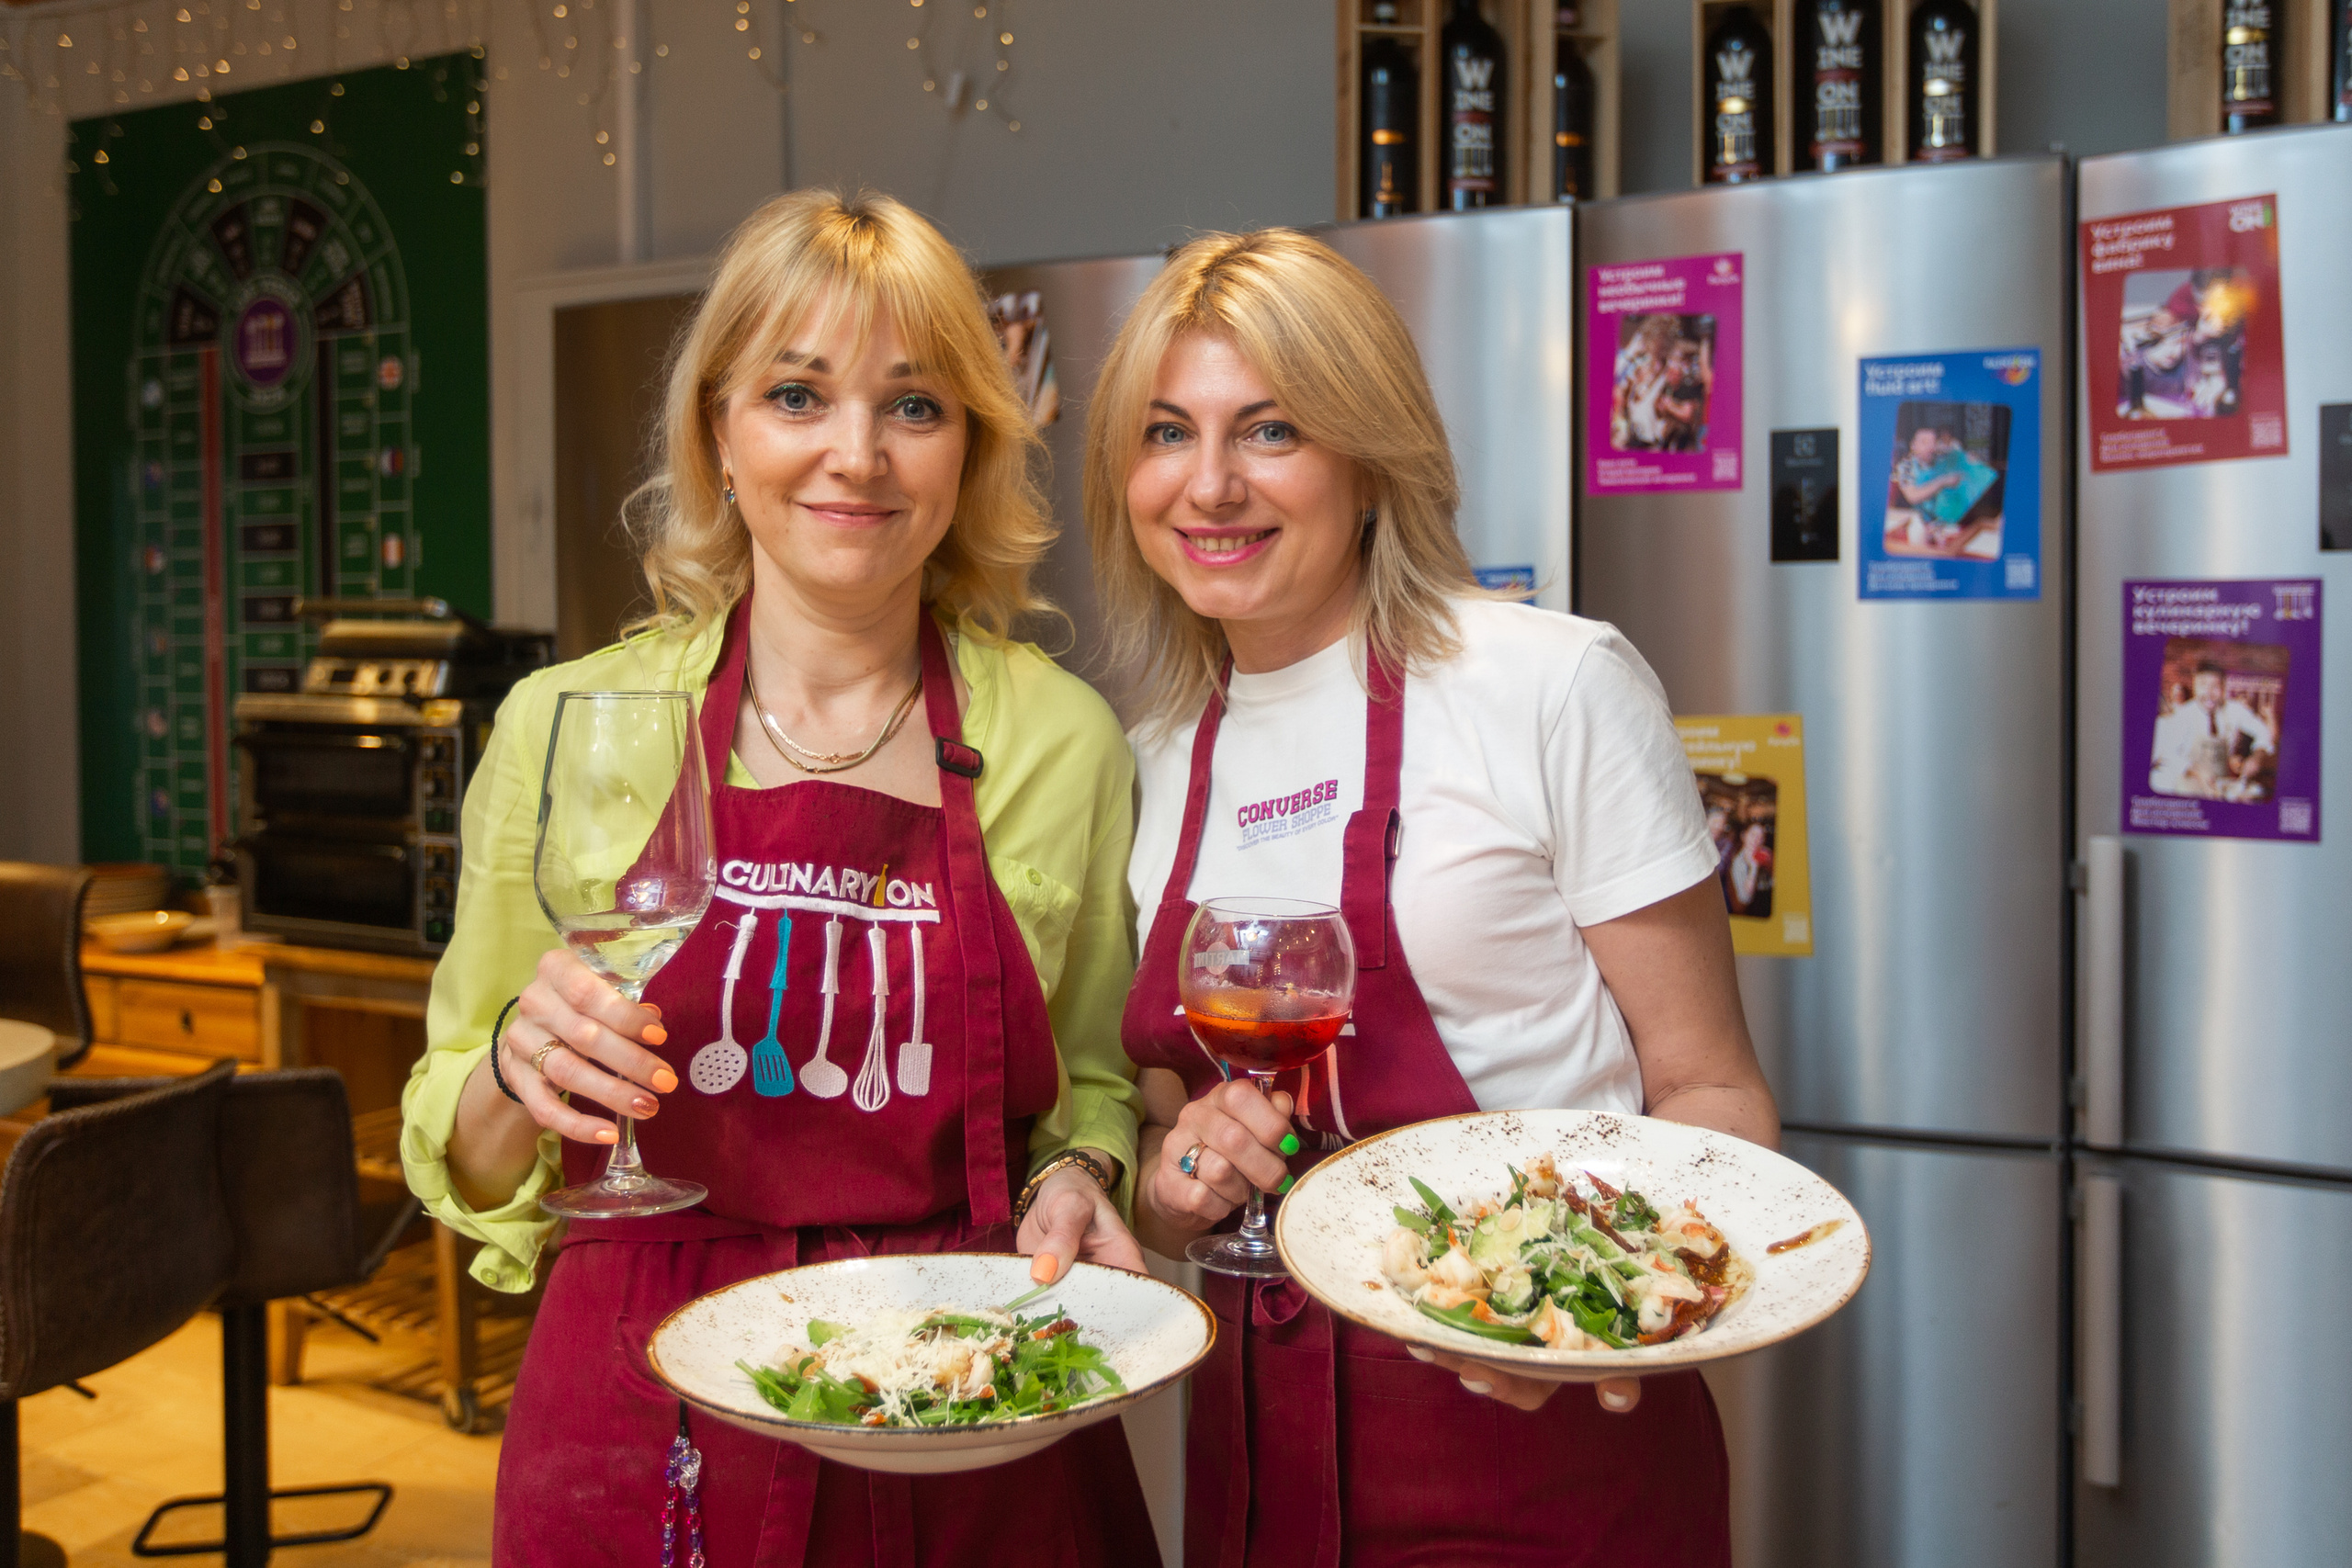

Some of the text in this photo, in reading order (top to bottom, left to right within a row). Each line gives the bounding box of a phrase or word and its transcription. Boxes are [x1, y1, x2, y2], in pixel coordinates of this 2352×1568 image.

[1238, 779, 1339, 828] CONVERSE
[1242, 803, 1331, 842] FLOWER SHOPPE
[1272, 830, 1294, 840] BEAUTY
